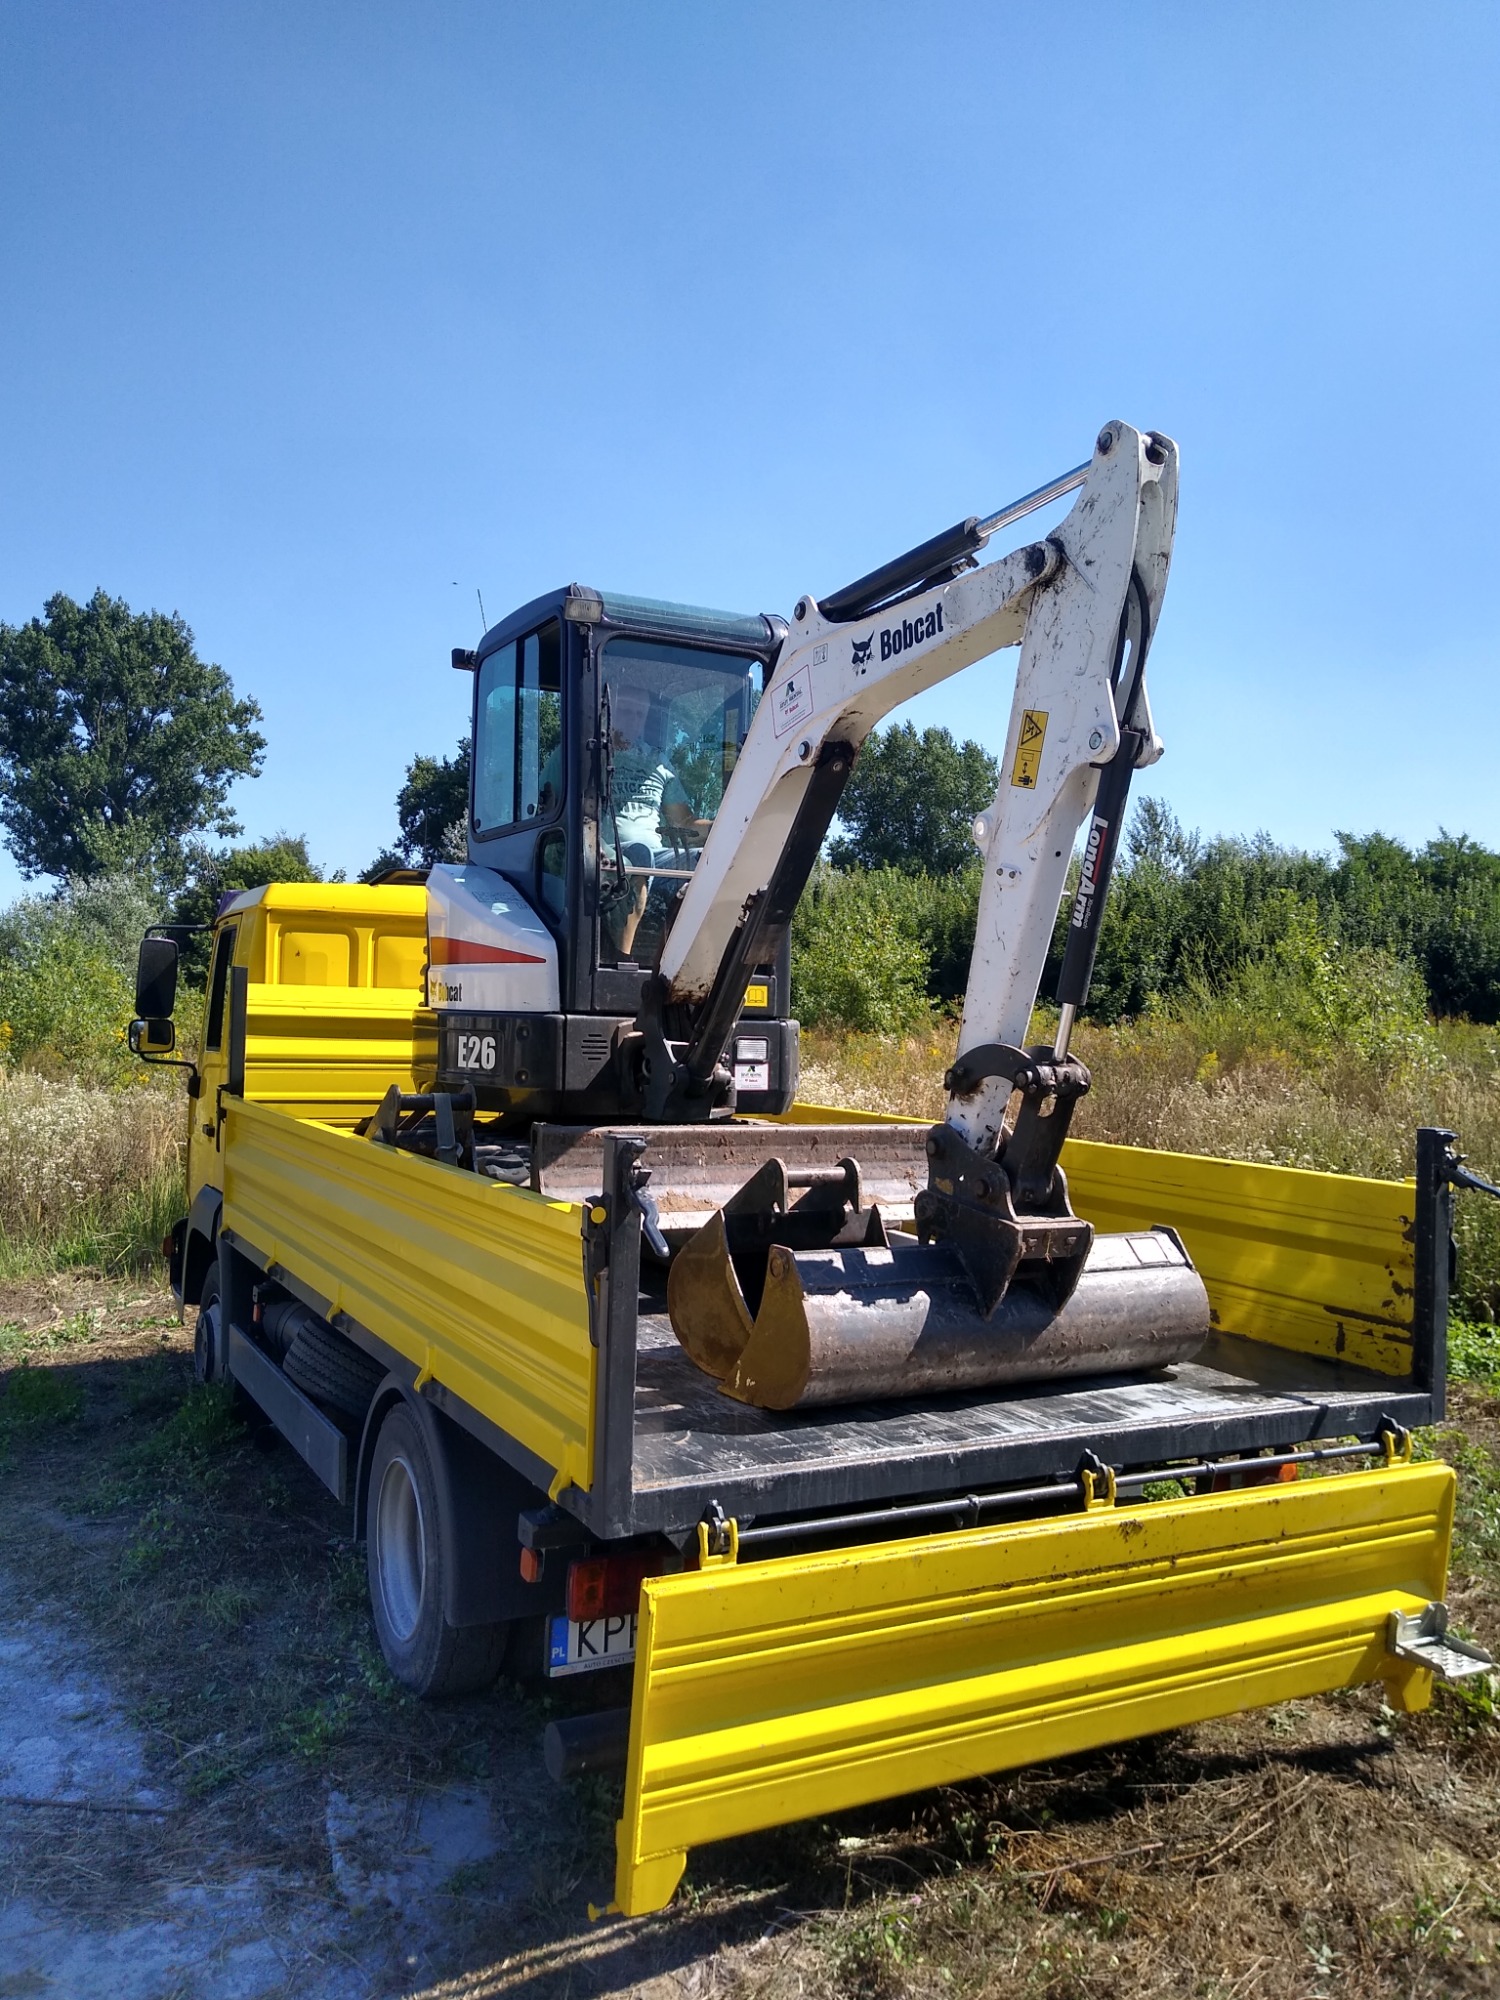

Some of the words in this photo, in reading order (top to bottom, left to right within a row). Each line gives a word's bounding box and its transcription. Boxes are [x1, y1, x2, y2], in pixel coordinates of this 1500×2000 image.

[880, 602, 944, 662] Bobcat
[1072, 815, 1109, 928] LongArm
[457, 1035, 496, 1070] E26
[551, 1646, 566, 1659] PL
